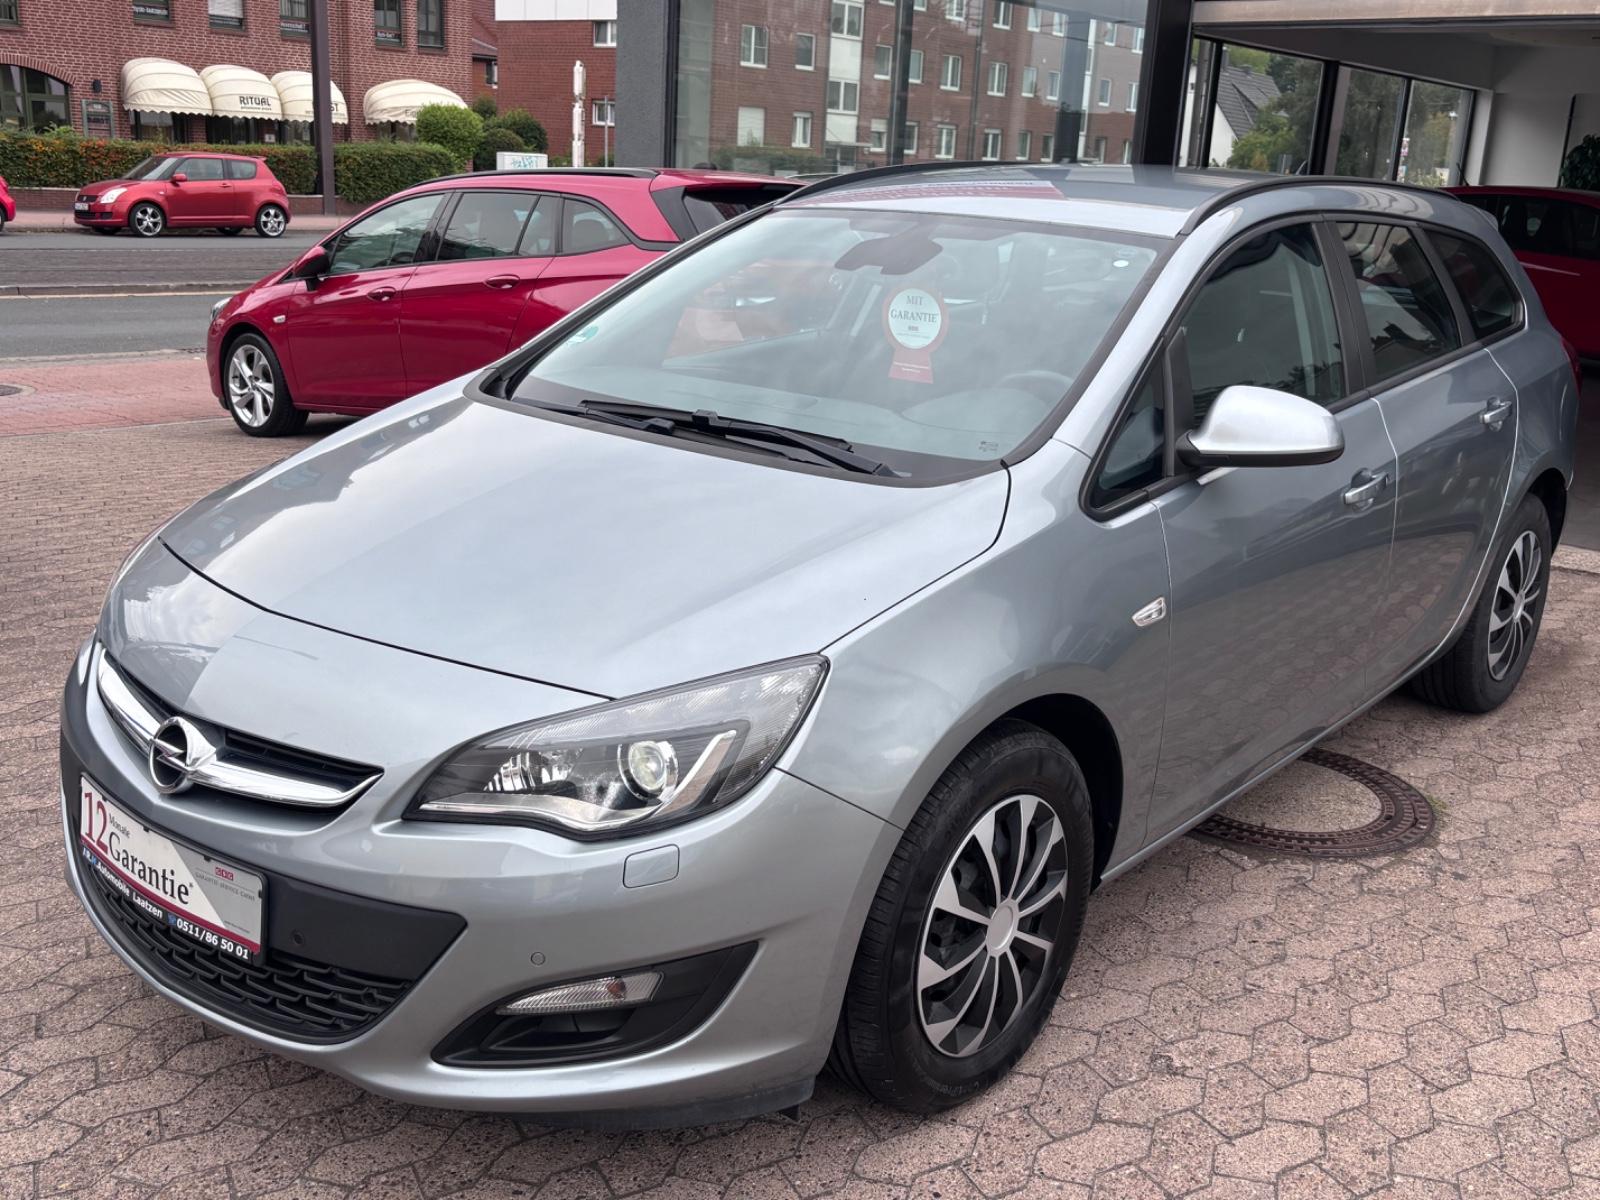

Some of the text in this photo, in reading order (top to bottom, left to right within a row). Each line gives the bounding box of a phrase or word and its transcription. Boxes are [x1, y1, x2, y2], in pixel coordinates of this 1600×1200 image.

[239, 95, 272, 107] RITUAL
[906, 295, 923, 306] MIT
[890, 308, 939, 323] GARANTIE
[84, 792, 109, 856] 12
[132, 891, 164, 919] Laatzen
[176, 918, 219, 946] 0511/86
[220, 938, 234, 953] 50
[235, 945, 249, 960] 01
